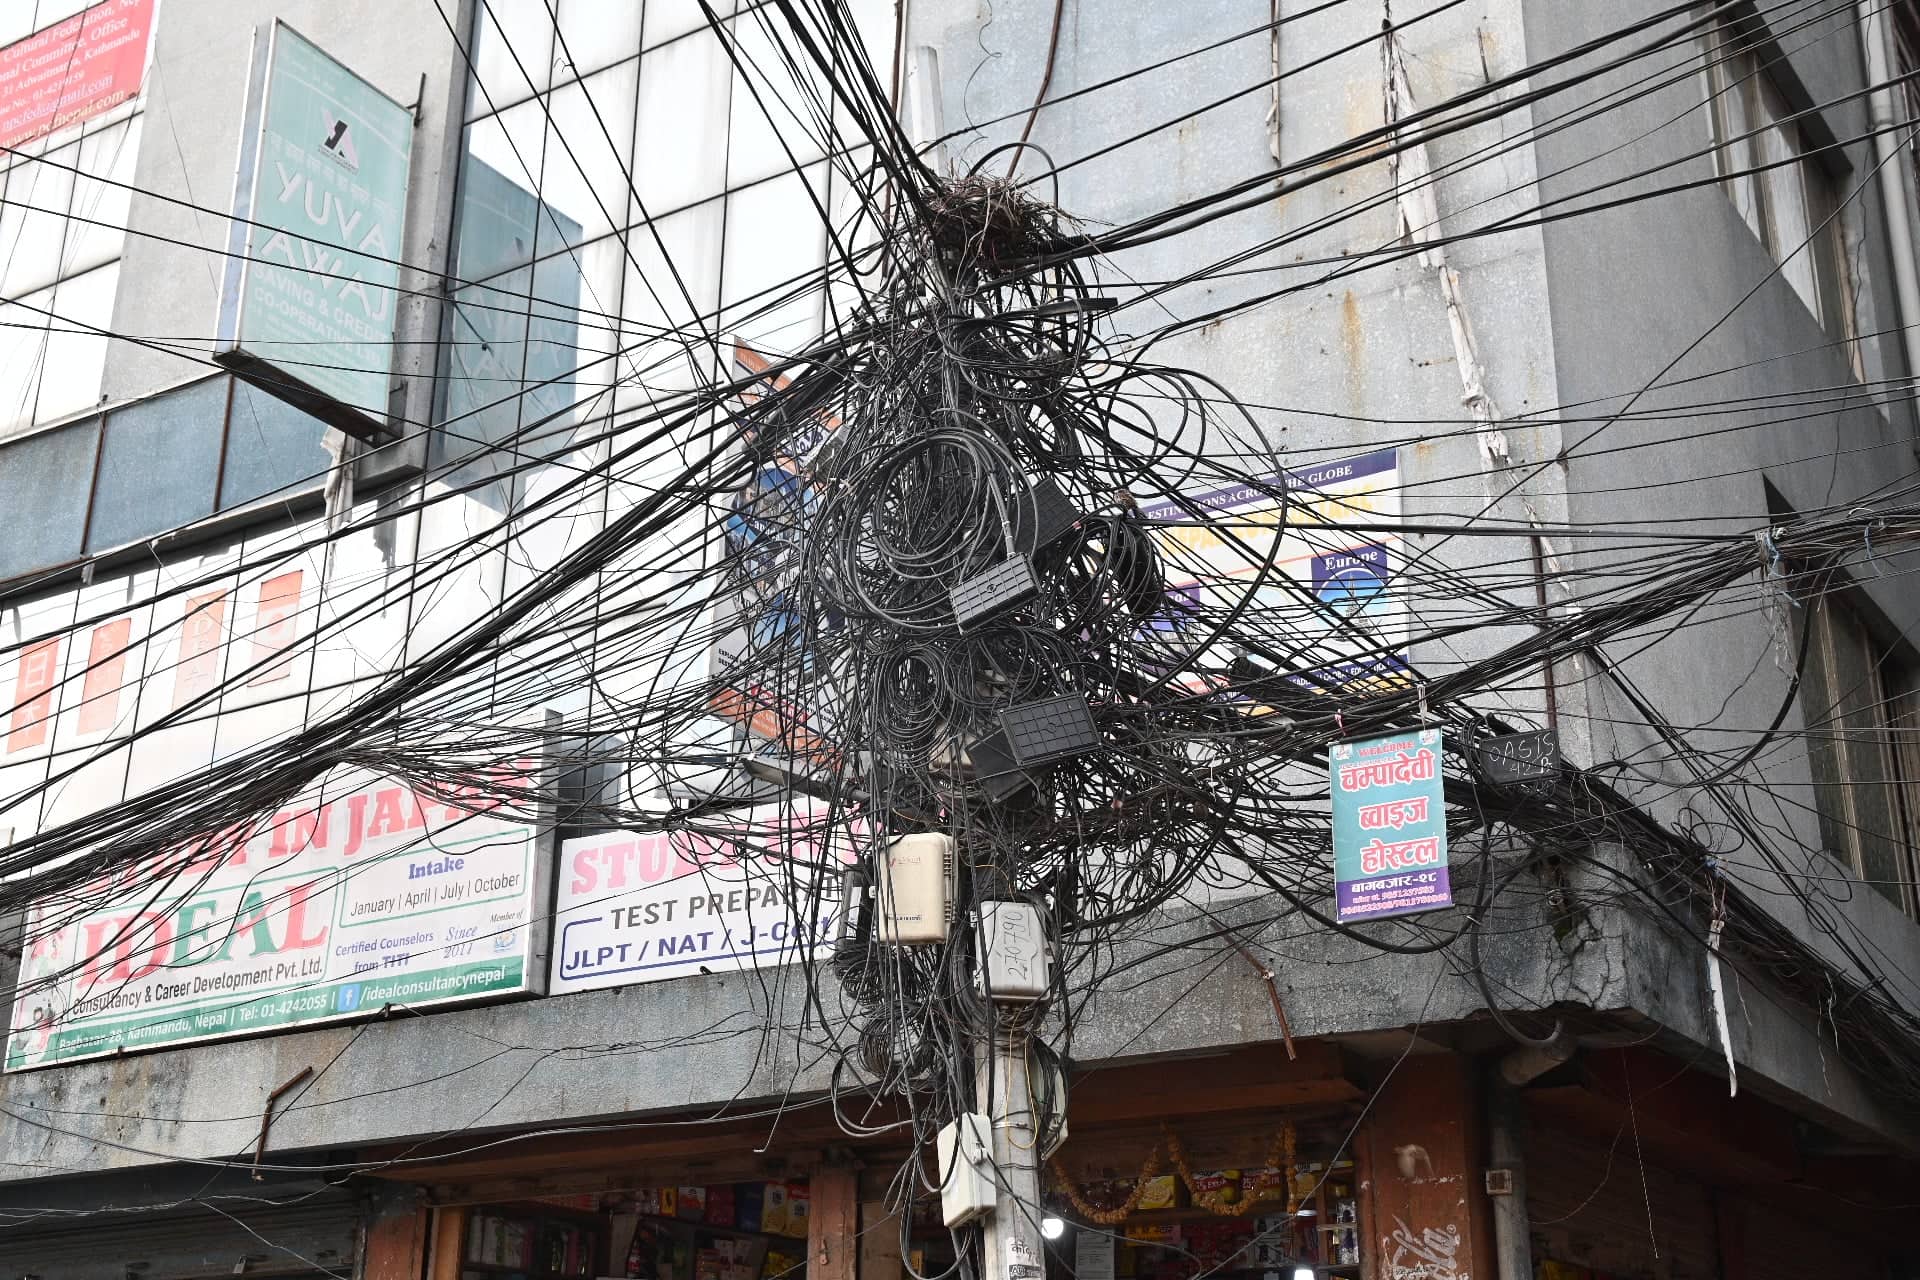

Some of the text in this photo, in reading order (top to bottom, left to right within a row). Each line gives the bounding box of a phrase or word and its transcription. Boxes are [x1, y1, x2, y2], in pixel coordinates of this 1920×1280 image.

[275, 160, 390, 267] YUVA
[254, 263, 314, 307] SAVING
[261, 226, 389, 320] AWAJ
[1308, 465, 1353, 483] GLOBE
[1325, 551, 1378, 570] Europe
[1489, 733, 1555, 765] OASIS
[269, 804, 332, 858] IN
[408, 857, 465, 880] Intake
[1361, 836, 1440, 873] होस्टल
[350, 896, 395, 917] January
[404, 887, 431, 909] April
[441, 882, 465, 900] July
[474, 873, 521, 894] October
[489, 910, 515, 924] Member
[611, 900, 679, 930] TEST
[77, 882, 328, 989] IDEAL
[335, 931, 434, 957] Certified Counselors
[445, 926, 479, 942] Since
[566, 943, 632, 971] JLPT
[658, 931, 714, 957] NAT
[354, 959, 379, 974] from
[73, 957, 323, 1015] Consultancy & Career Development Pvt. Ltd.
[128, 1020, 192, 1042] Kathmandu,
[195, 1010, 226, 1033] Nepal
[240, 1005, 259, 1021] Tel:
[261, 994, 328, 1018] 01-4242055
